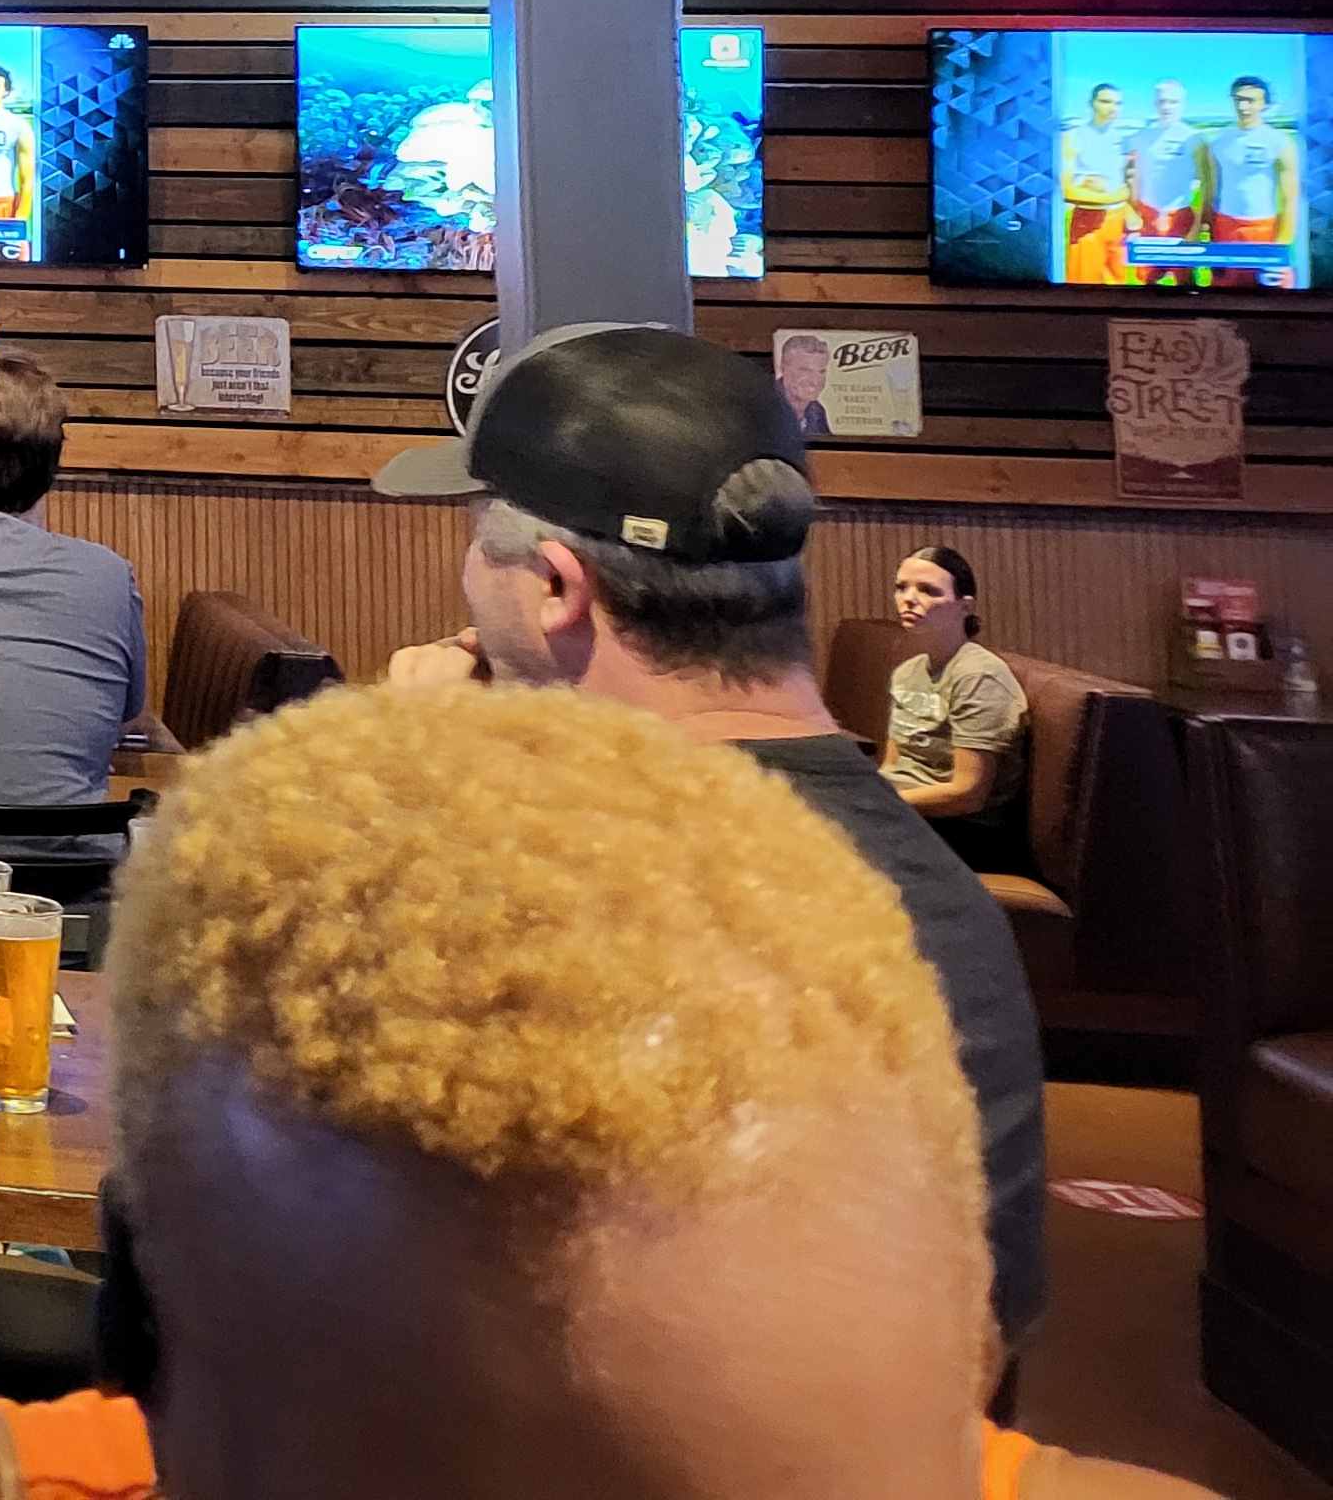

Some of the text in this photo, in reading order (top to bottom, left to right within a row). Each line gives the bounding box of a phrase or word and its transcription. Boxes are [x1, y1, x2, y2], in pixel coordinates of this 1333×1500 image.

[200, 323, 281, 367] BEER
[833, 338, 911, 369] BEER
[1118, 330, 1208, 375] EASY
[200, 365, 281, 380] because your friends
[211, 380, 227, 392] just
[253, 381, 270, 391] that
[1109, 374, 1246, 425] STREET
